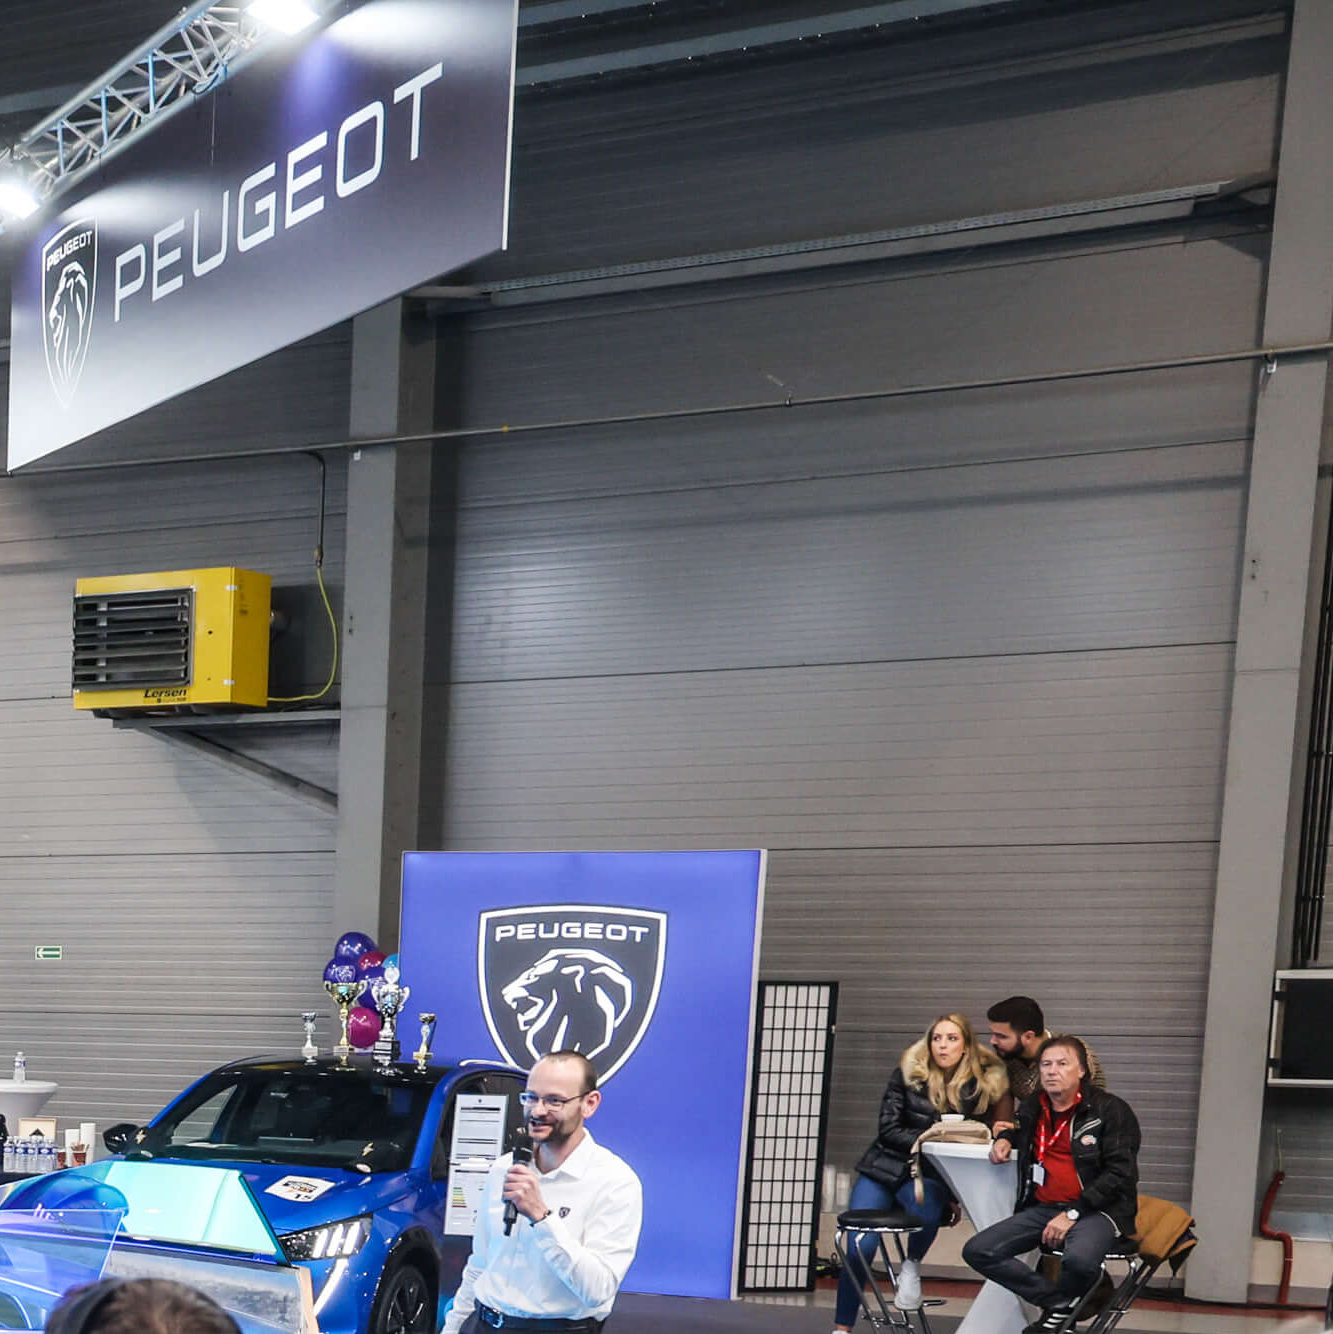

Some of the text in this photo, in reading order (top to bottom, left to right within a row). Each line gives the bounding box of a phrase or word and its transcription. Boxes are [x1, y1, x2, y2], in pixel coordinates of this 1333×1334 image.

[114, 62, 444, 323] PEUGEOT
[46, 229, 93, 272] PEUGEOT
[495, 922, 650, 942] PEUGEOT
